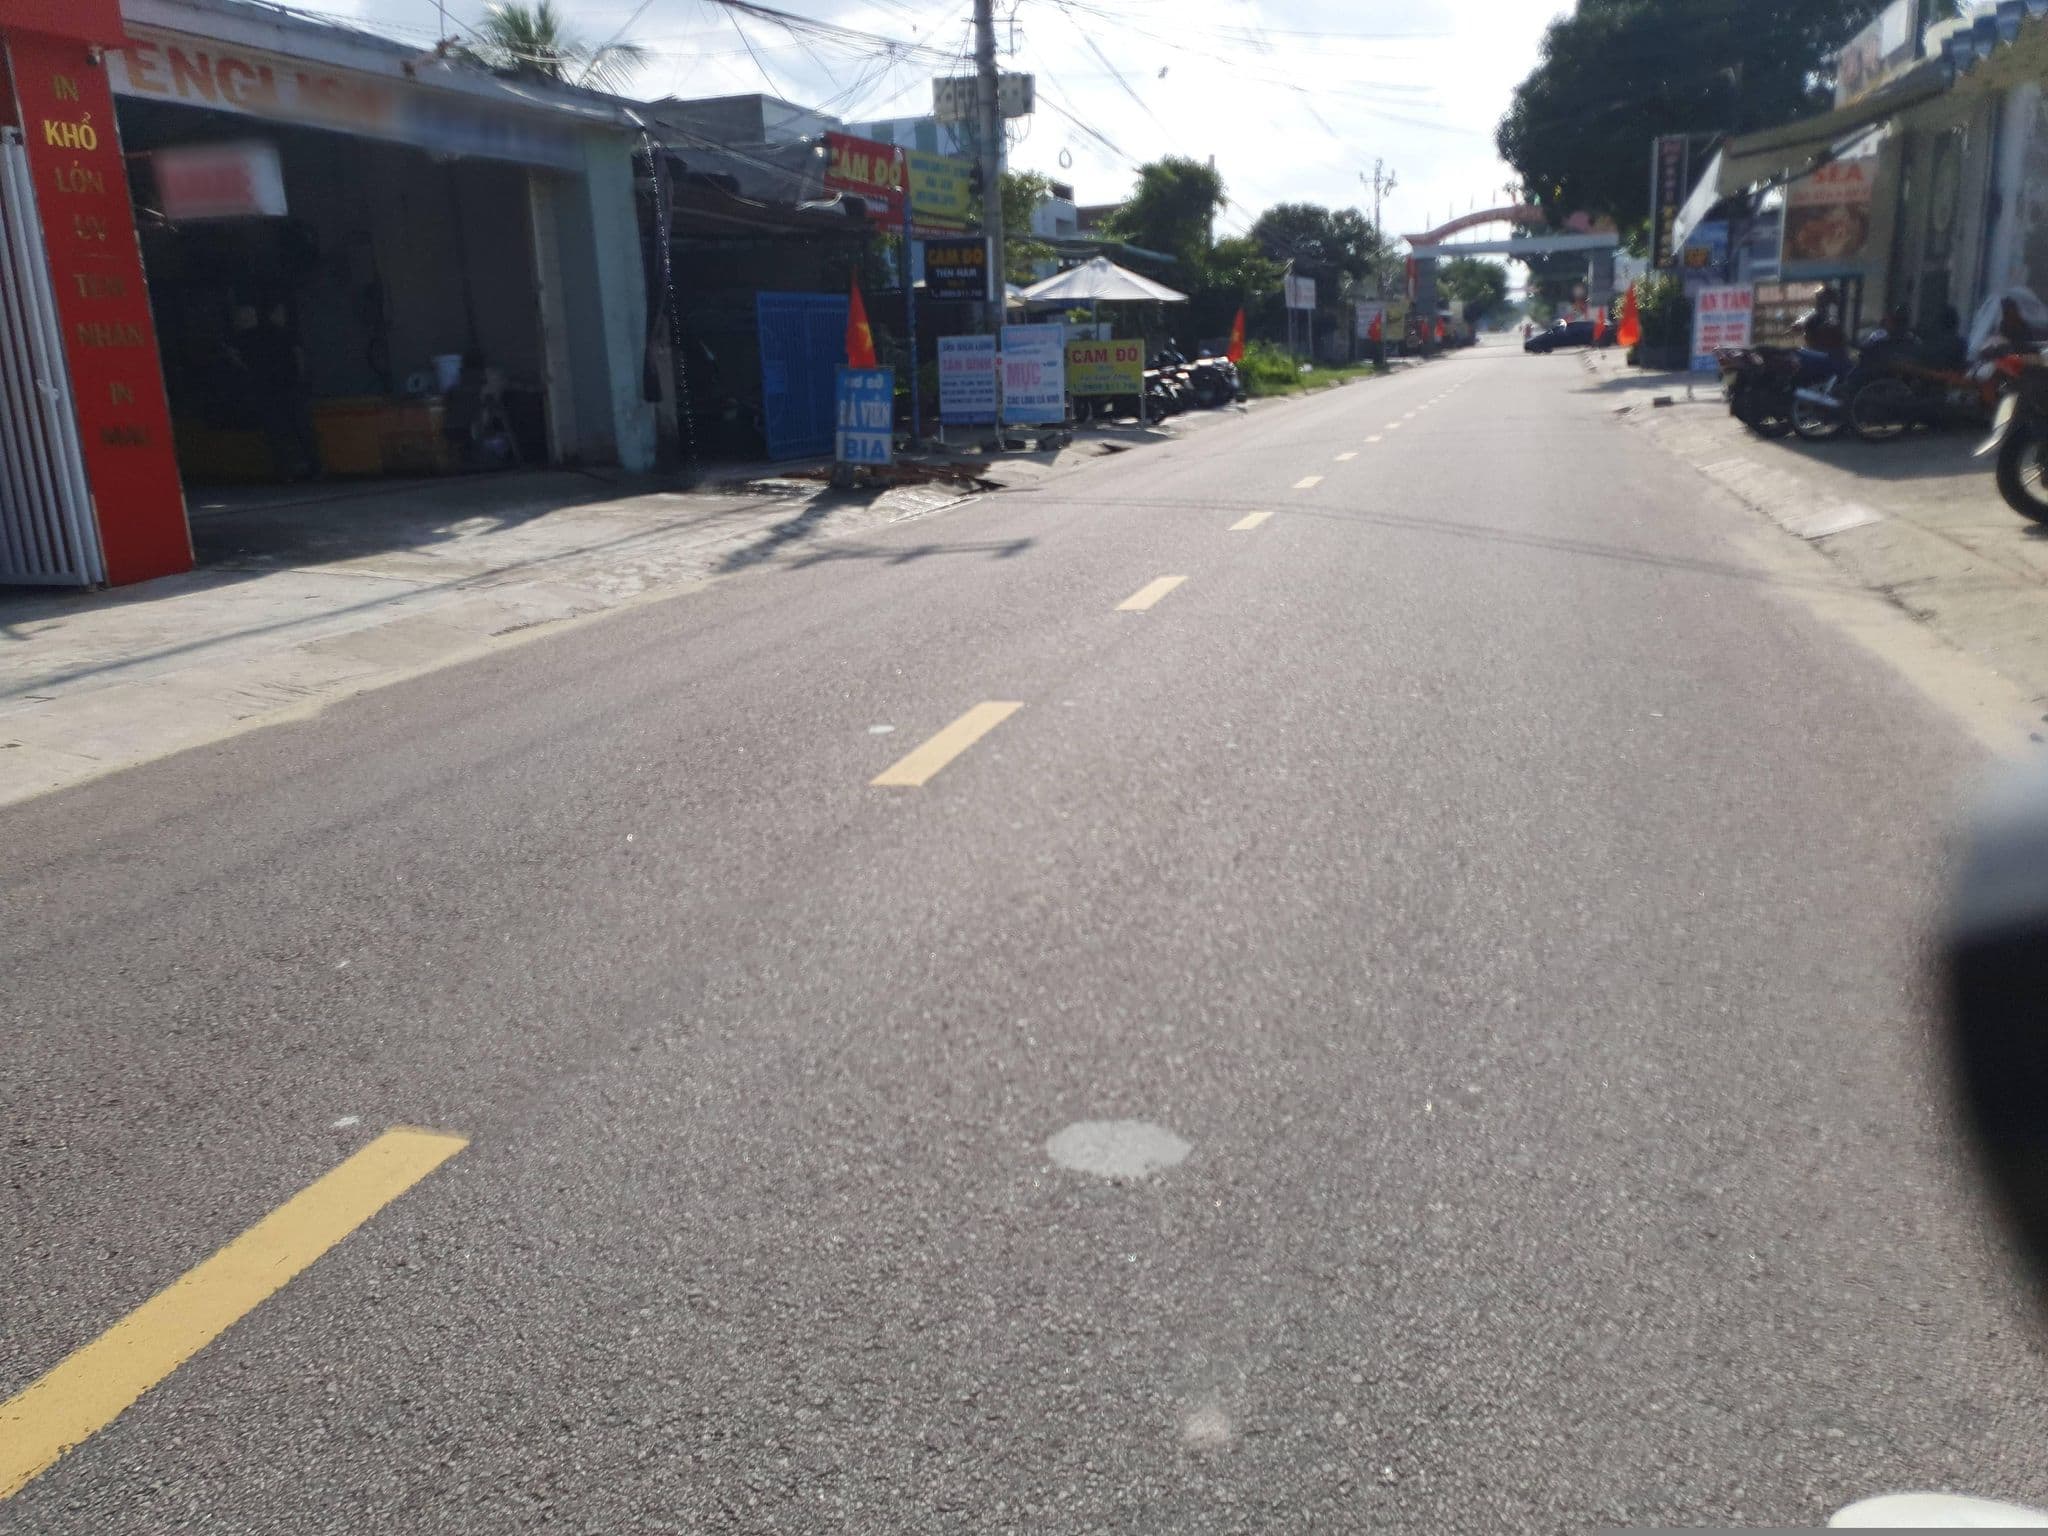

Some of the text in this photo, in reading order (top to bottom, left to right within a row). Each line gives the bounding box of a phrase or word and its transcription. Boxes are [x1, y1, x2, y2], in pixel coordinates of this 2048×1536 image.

[53, 74, 80, 101] IN
[43, 112, 98, 151] KHỔ
[54, 159, 105, 193] LỚN
[847, 440, 886, 459] BIA
